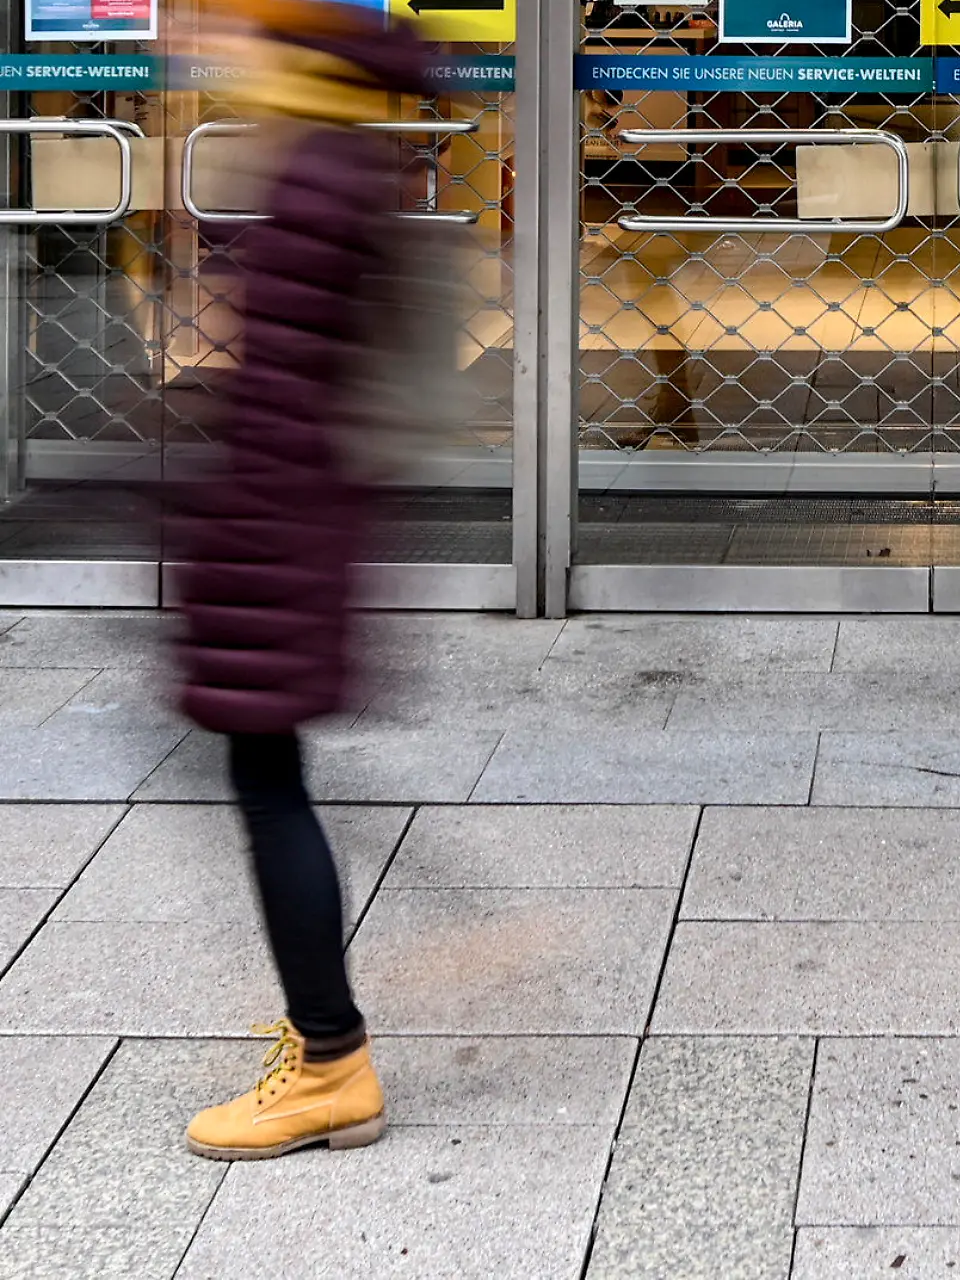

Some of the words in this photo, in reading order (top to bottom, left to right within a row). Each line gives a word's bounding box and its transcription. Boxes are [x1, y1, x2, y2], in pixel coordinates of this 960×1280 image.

[766, 20, 803, 29] GALERIA
[26, 66, 149, 78] SERVICE-WELTEN!
[592, 67, 668, 79] ENTDECKEN
[672, 67, 690, 79] SIE
[695, 67, 744, 80] UNSERE
[748, 68, 793, 80] NEUEN
[797, 67, 921, 81] SERVICE-WELTEN!
